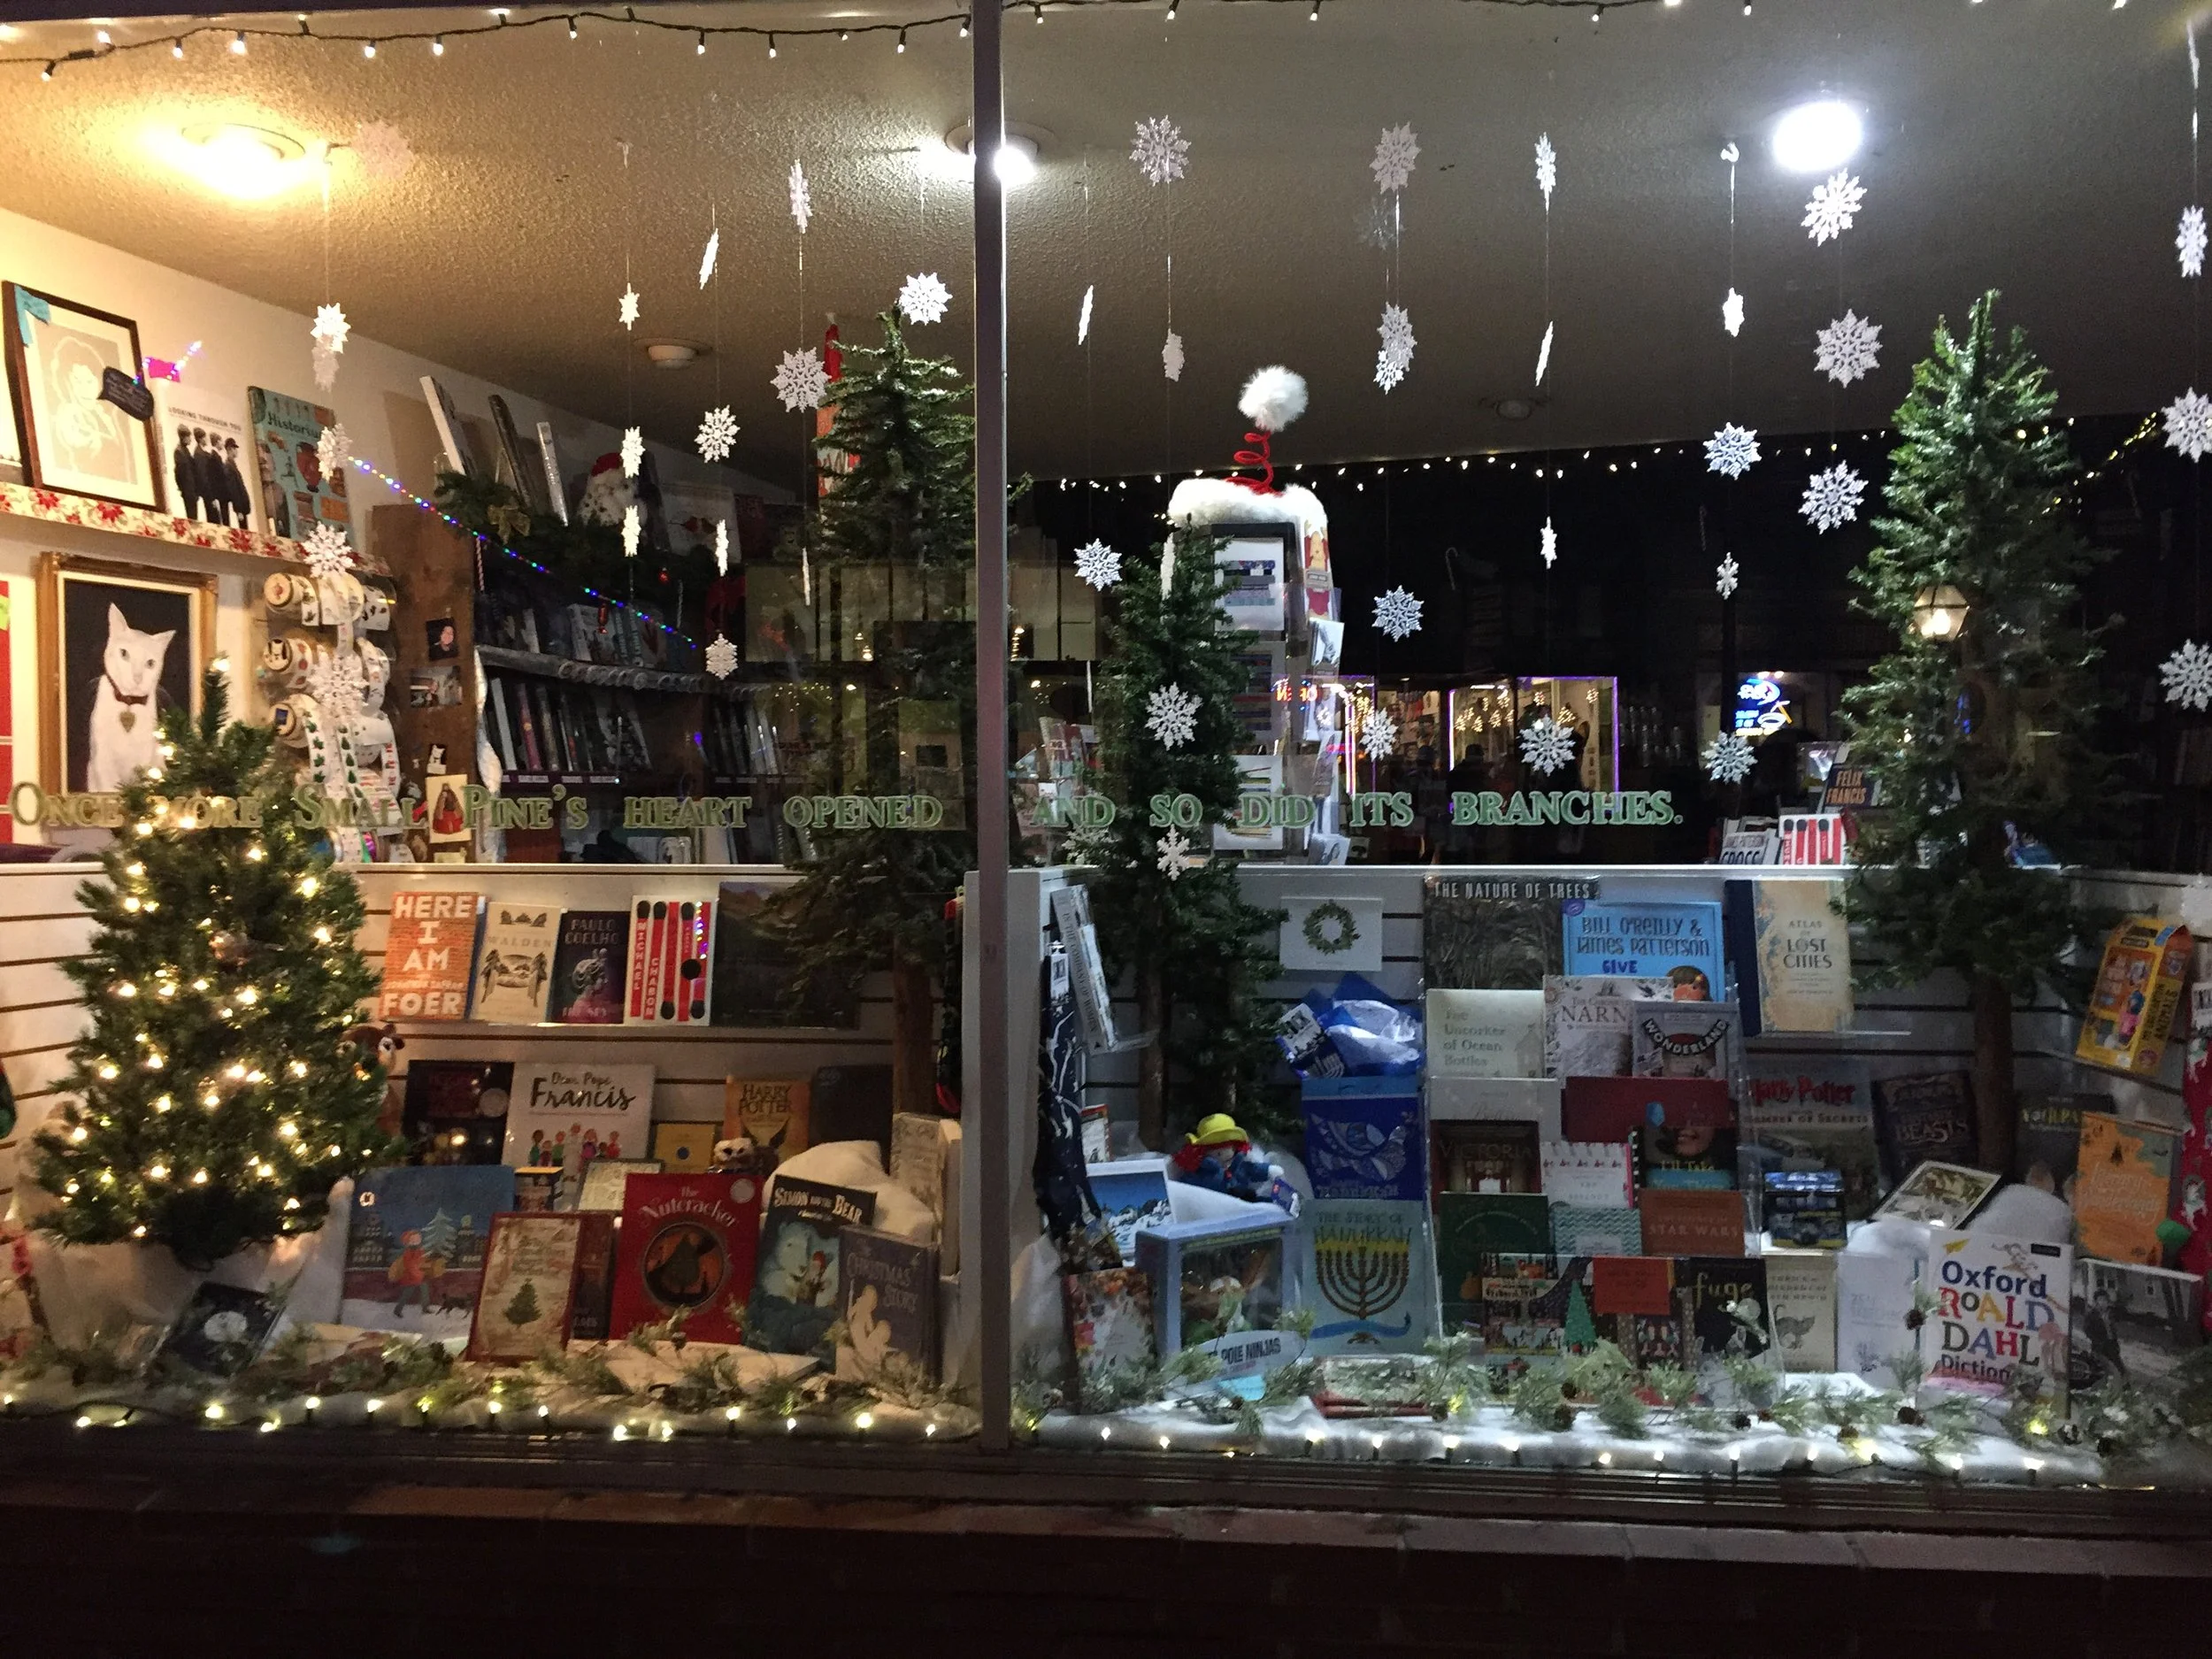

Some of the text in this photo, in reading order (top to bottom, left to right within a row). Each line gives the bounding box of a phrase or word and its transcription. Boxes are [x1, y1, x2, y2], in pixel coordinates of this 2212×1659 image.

[267, 411, 321, 440] Historiu
[1825, 769, 1867, 805] FELIX FRANCIS
[10, 781, 1685, 831] ONCE MORE SMALL PINE'S HEART OPENED AND SO DID ITS BRANCHES.
[1433, 882, 1591, 900] THE NATURE OF TREES
[394, 895, 472, 919] HERE
[417, 920, 441, 945] I
[571, 918, 617, 932] PAULO
[1689, 918, 1703, 937] &
[488, 935, 552, 948] WALDEN
[564, 931, 620, 945] COELHO
[1786, 938, 1827, 954] LOST
[402, 947, 450, 972] AM
[633, 921, 647, 991] MICHAEL
[1602, 959, 1639, 973] GIVE
[1783, 954, 1833, 969] CITIES
[644, 956, 659, 1017] CHABON
[382, 992, 461, 1016] FOER
[1561, 1004, 1627, 1024] NARN
[1443, 1039, 1502, 1051] of Ocean
[1642, 1018, 1730, 1056] WONDERLAND
[531, 1076, 636, 1110] Francis
[742, 1083, 793, 1100] HARRY
[738, 1096, 793, 1116] POTTER
[1817, 1112, 1869, 1125] SECRETS
[1439, 1141, 1533, 1159] VICTORIA
[639, 1196, 739, 1228] Nutcracker
[1941, 1260, 2047, 1299] Oxford
[1937, 1286, 2055, 1333] ROALD
[1941, 1321, 2040, 1368] DAHL
[1940, 1354, 2011, 1386] Diction
